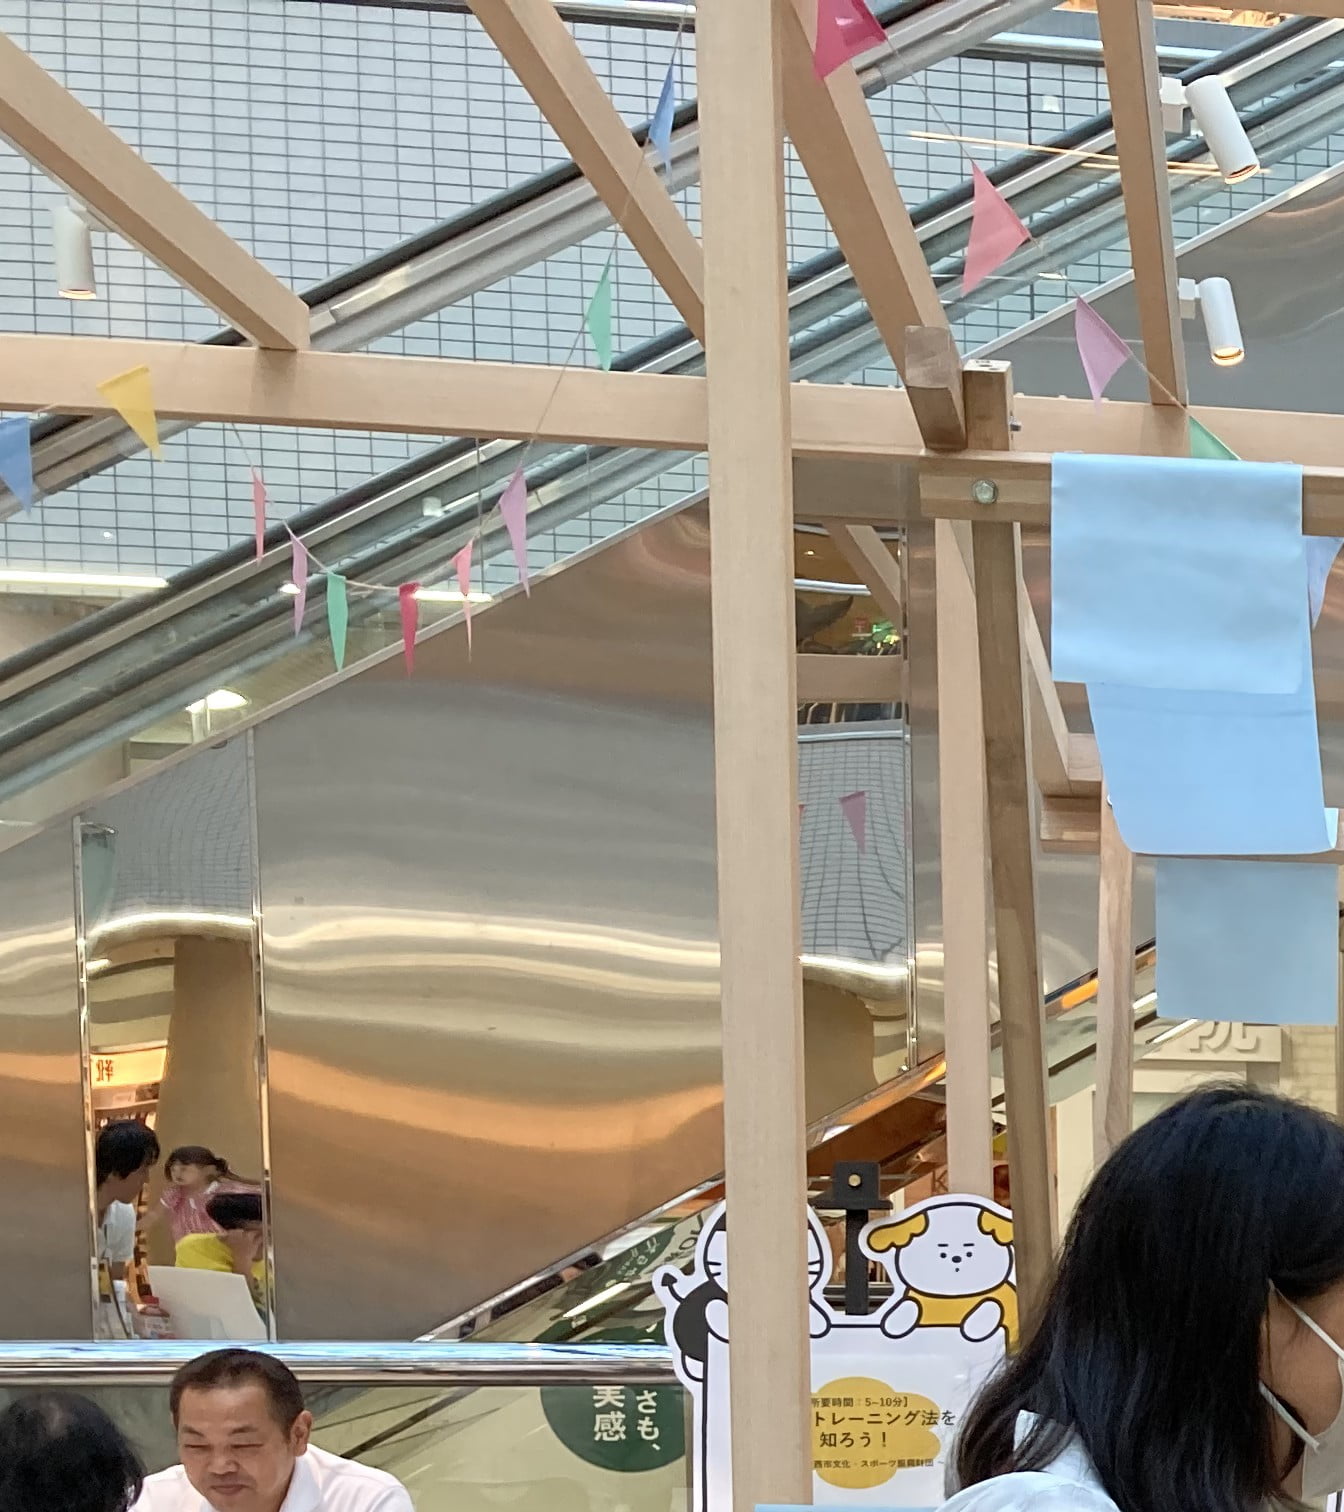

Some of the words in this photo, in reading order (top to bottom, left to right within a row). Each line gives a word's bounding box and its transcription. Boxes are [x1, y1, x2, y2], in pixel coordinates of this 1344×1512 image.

[814, 1409, 957, 1427] トレーニング法を
[819, 1430, 888, 1449] 知ろう！
